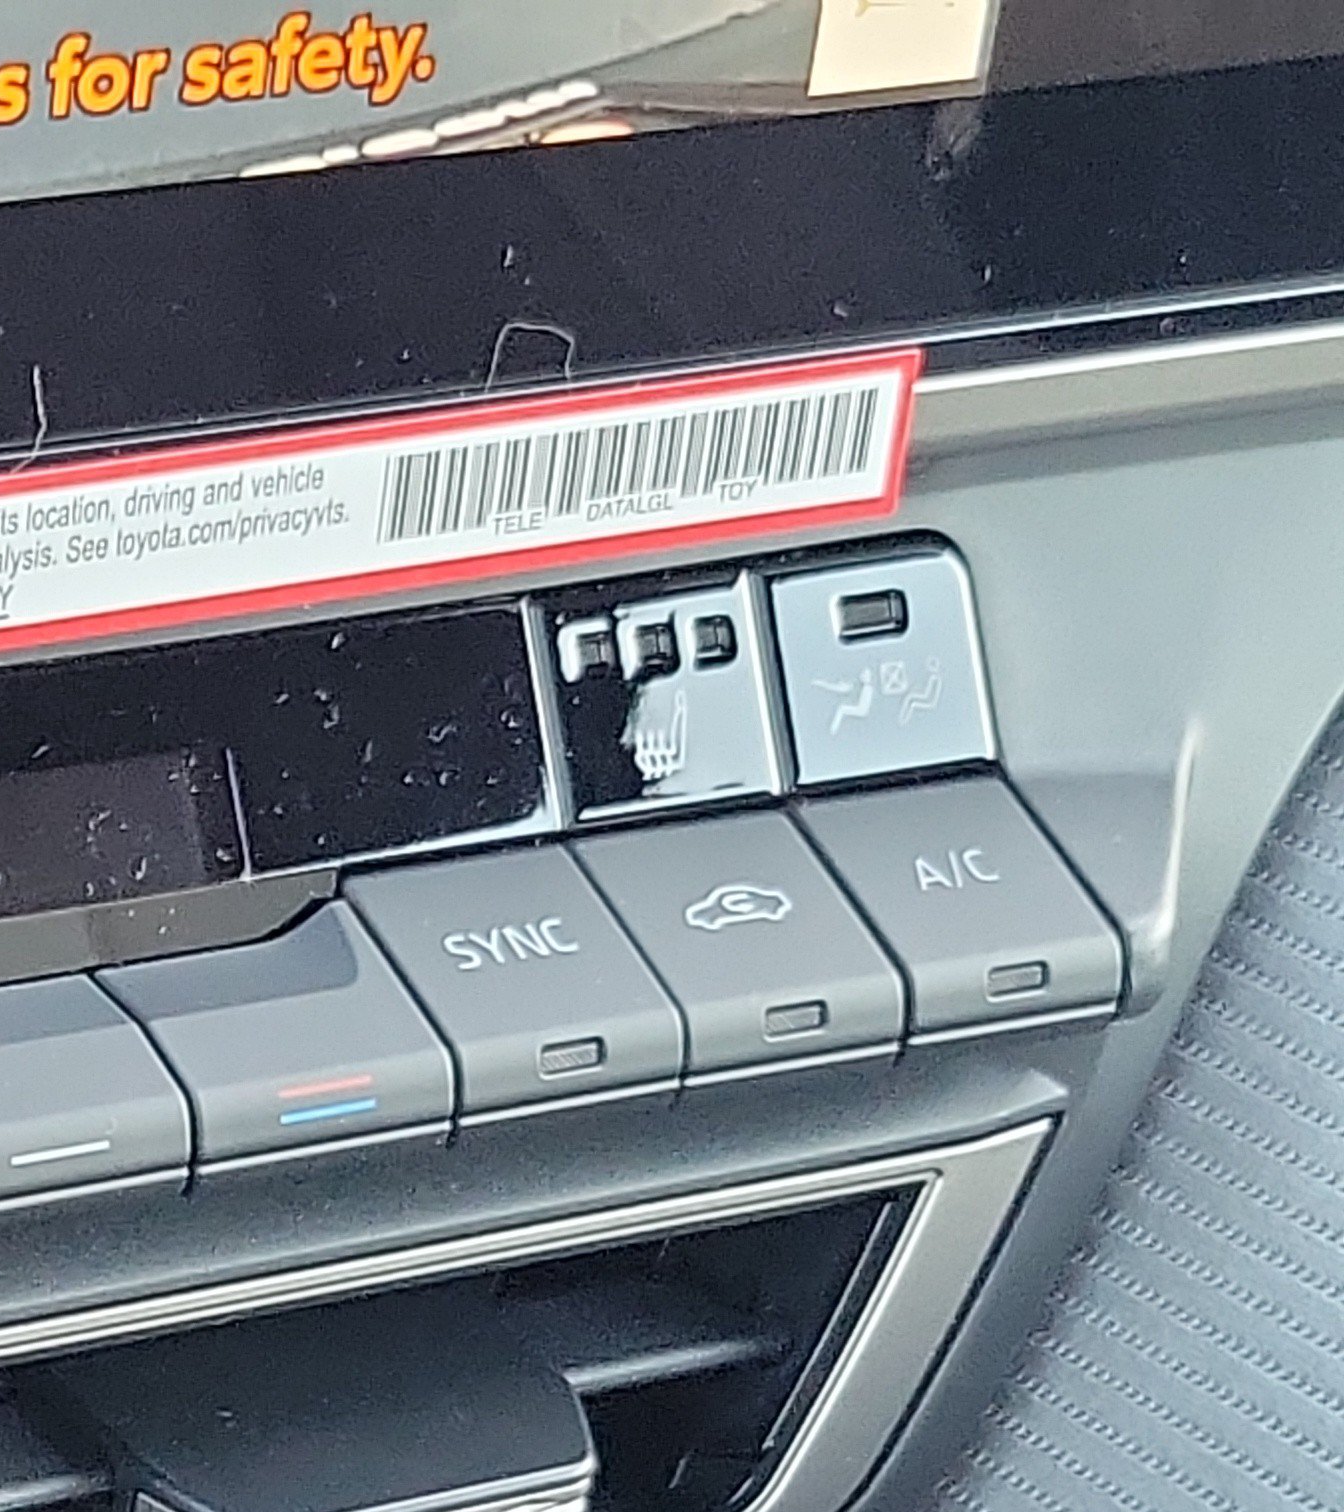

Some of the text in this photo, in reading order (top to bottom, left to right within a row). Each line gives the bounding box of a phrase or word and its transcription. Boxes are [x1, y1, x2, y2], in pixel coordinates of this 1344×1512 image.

[45, 32, 168, 118] for
[178, 10, 436, 115] safety.
[25, 496, 115, 532] location,
[124, 485, 195, 517] driving
[203, 471, 243, 505] and
[251, 462, 325, 498] vehicle
[493, 511, 543, 536] TELE
[718, 478, 758, 502] TOY
[66, 533, 108, 563] See
[913, 848, 1000, 891] A/C
[444, 916, 579, 970] SYNC
